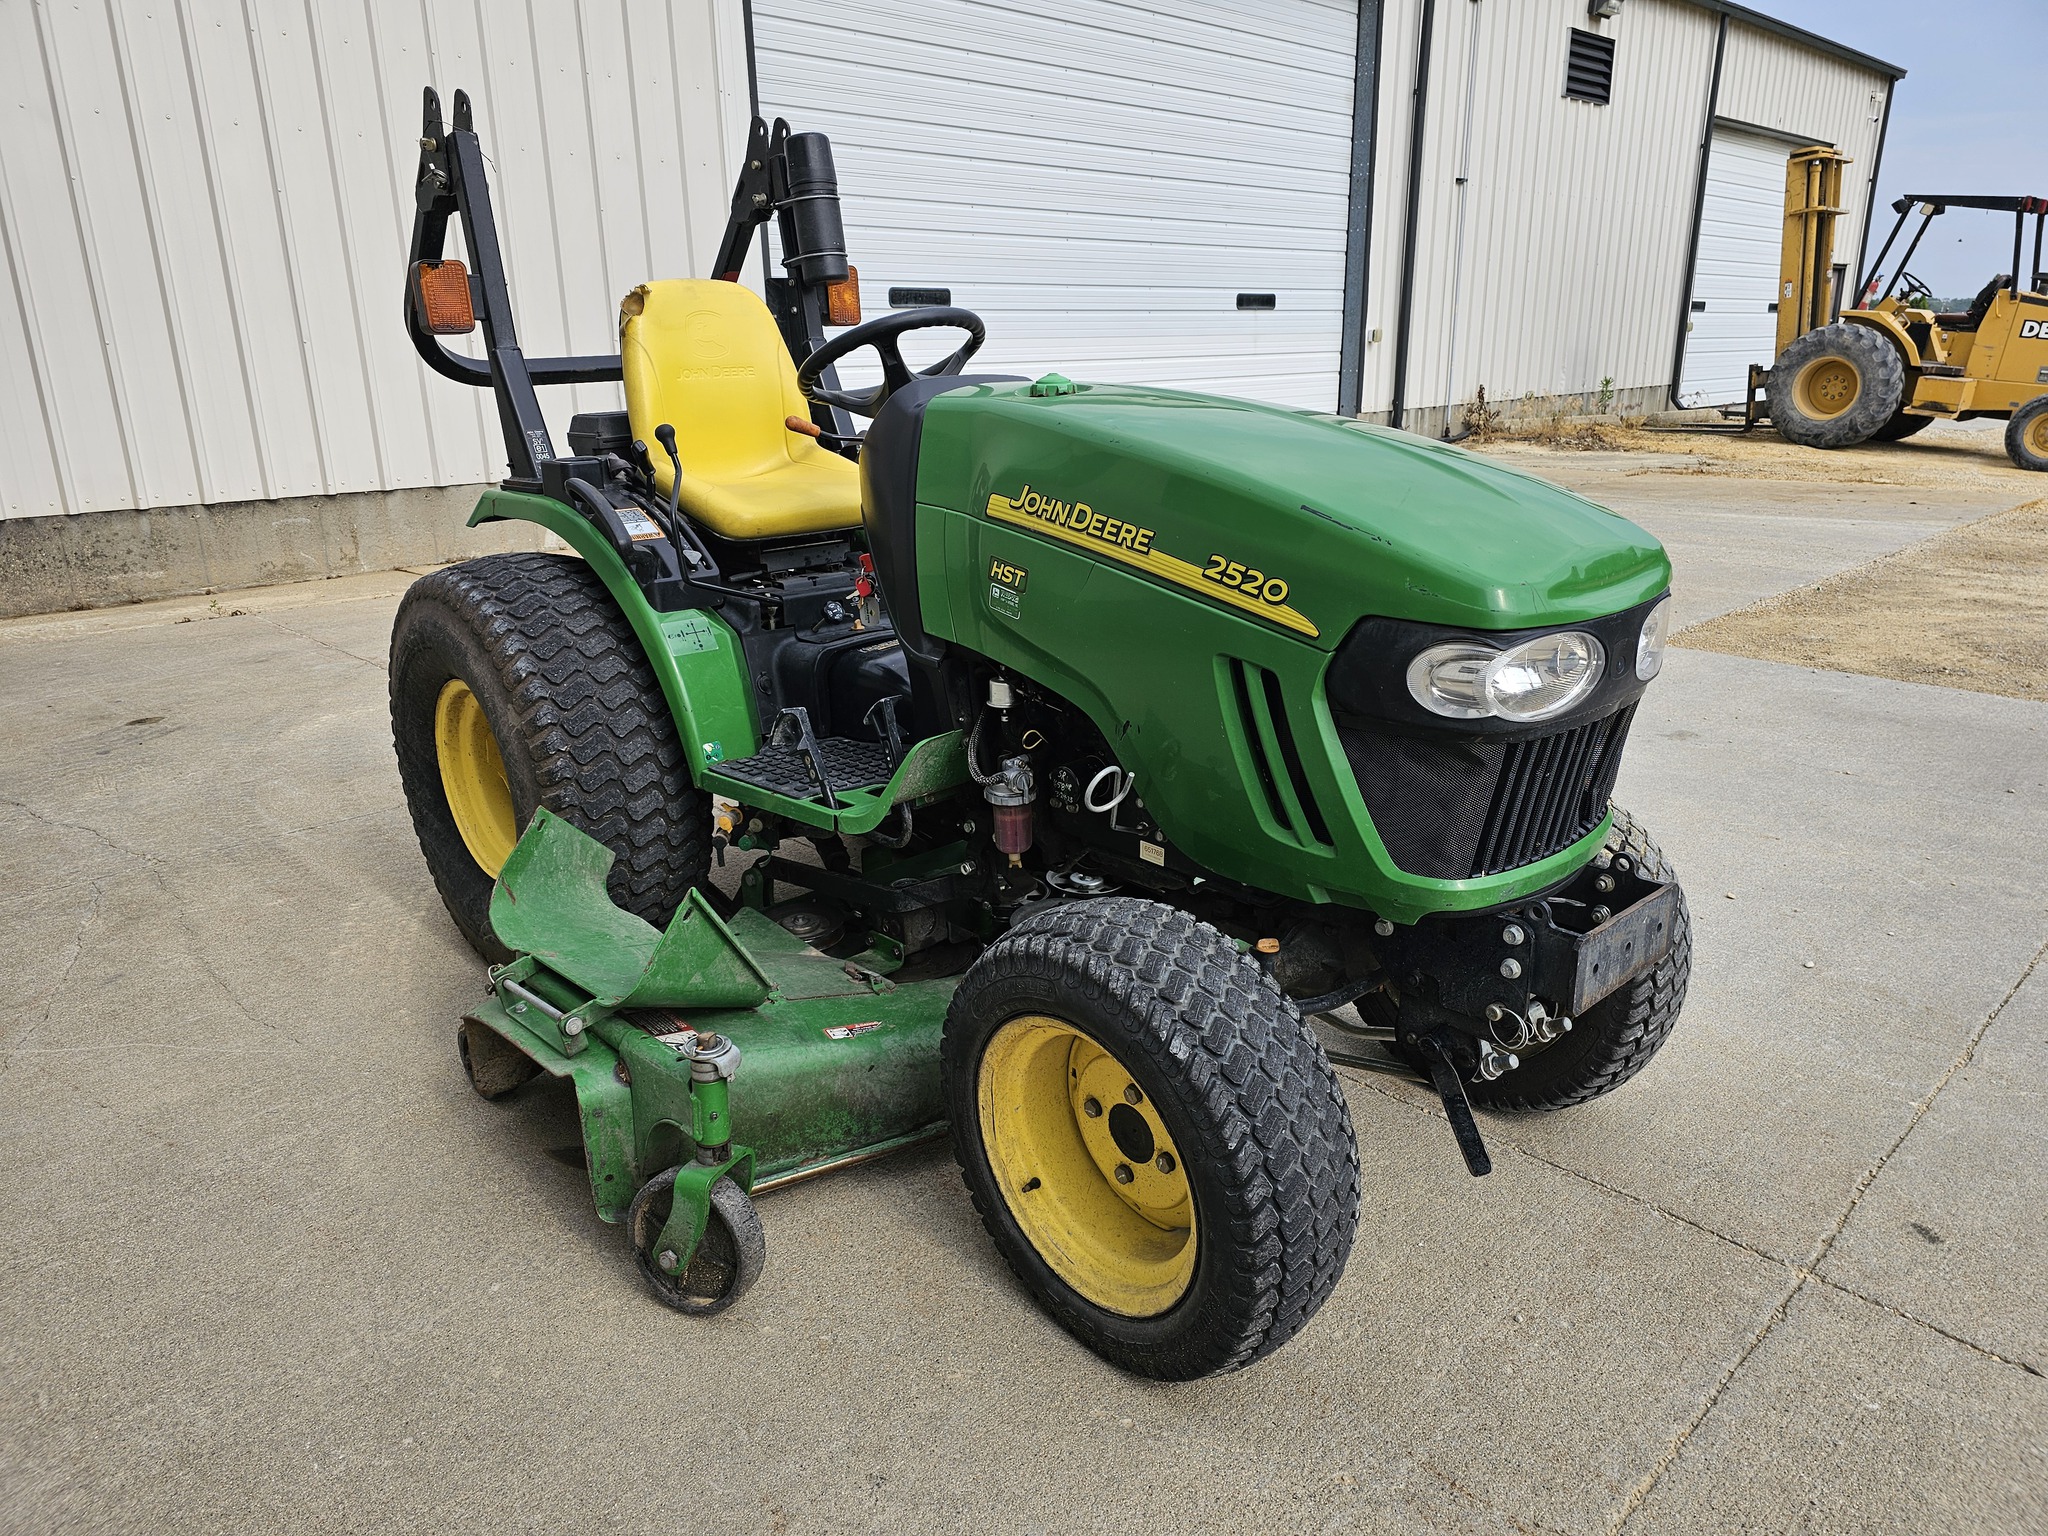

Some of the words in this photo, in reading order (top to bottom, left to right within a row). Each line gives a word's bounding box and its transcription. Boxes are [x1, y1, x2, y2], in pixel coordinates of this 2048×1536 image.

[676, 367, 711, 381] JOHN
[711, 365, 756, 379] DEERE
[1010, 485, 1071, 528] JOHN
[1069, 502, 1156, 554] DEERE
[990, 560, 1026, 587] HST
[1203, 554, 1290, 605] 2520
